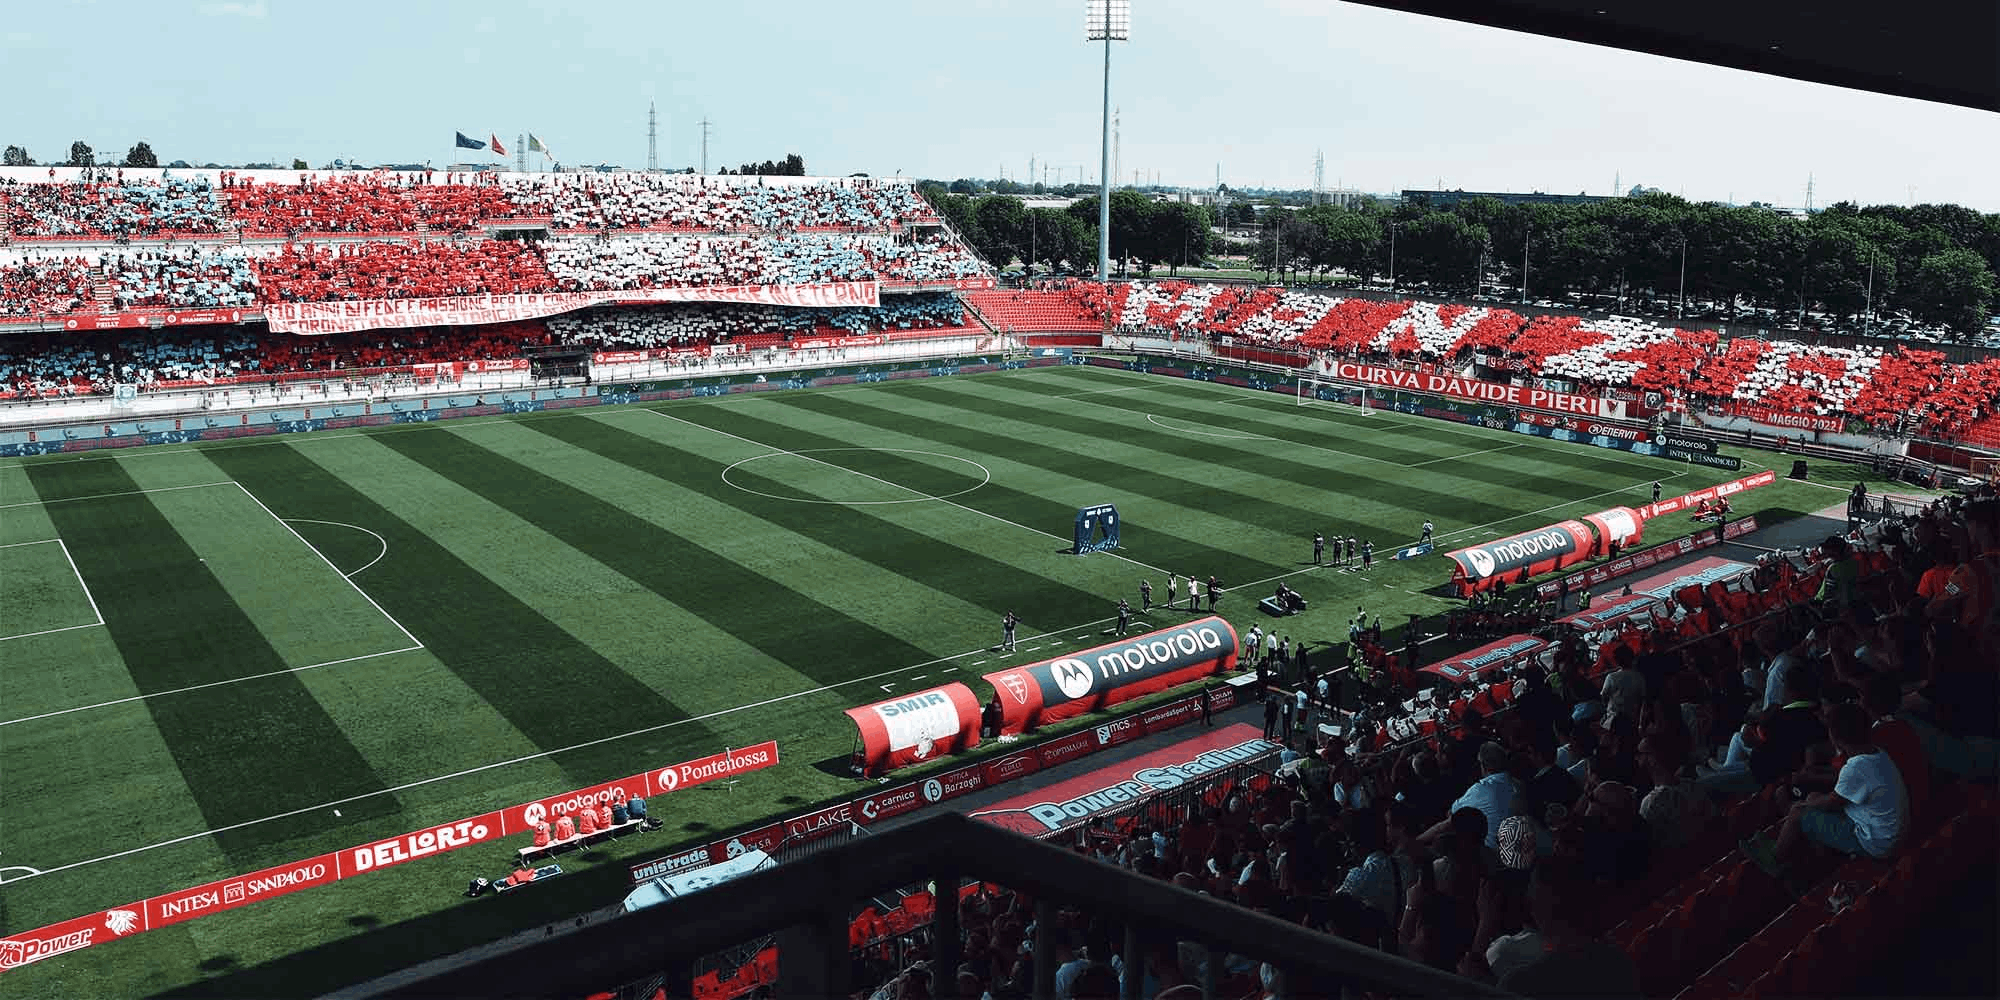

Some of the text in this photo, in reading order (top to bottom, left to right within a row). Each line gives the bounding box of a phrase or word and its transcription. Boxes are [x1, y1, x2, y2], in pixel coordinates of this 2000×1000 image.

[1339, 363, 1425, 392] CURVA
[1429, 374, 1521, 403] DAVIDE
[1530, 388, 1597, 415] PIERI
[1601, 425, 1638, 441] ENERVIT
[1767, 412, 1810, 428] MAGGIO
[1811, 418, 1838, 431] 2022
[1668, 437, 1708, 450] motorola
[1493, 529, 1569, 564] motorola
[1097, 626, 1222, 679] motorola
[884, 688, 945, 718] SMIR
[1110, 719, 1130, 734] mcs
[680, 750, 769, 783] Pontenossa
[882, 790, 916, 807] carnico
[944, 775, 982, 794] Barzaghi
[550, 786, 626, 817] motorola
[805, 807, 852, 833] LAKE
[633, 848, 709, 881] unistrade
[162, 863, 326, 919] INTESA SANPAOLO
[22, 928, 94, 963] Power
